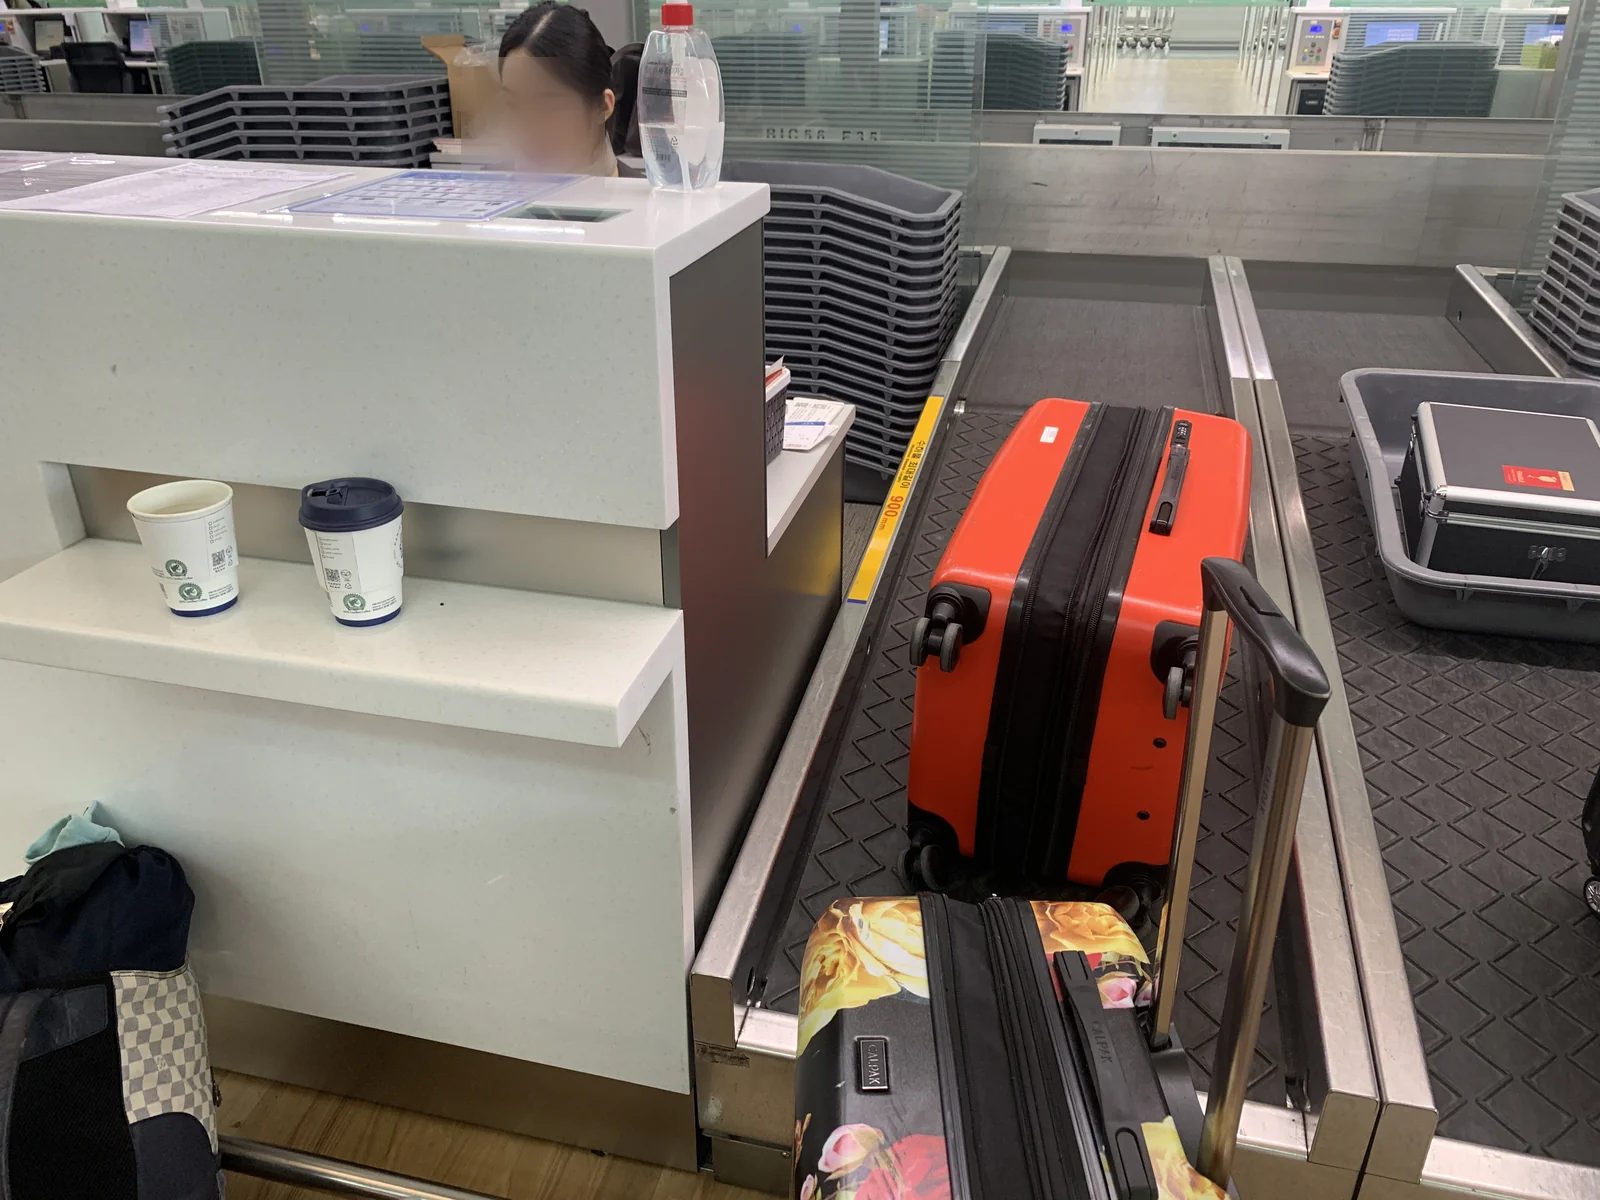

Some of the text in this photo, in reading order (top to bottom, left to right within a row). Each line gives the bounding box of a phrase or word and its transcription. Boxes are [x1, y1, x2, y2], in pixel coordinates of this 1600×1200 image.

[878, 440, 926, 530] 수하물 최대길이 900 mm
[1091, 1020, 1113, 1064] CALPAK
[867, 1044, 881, 1085] CALPAK
